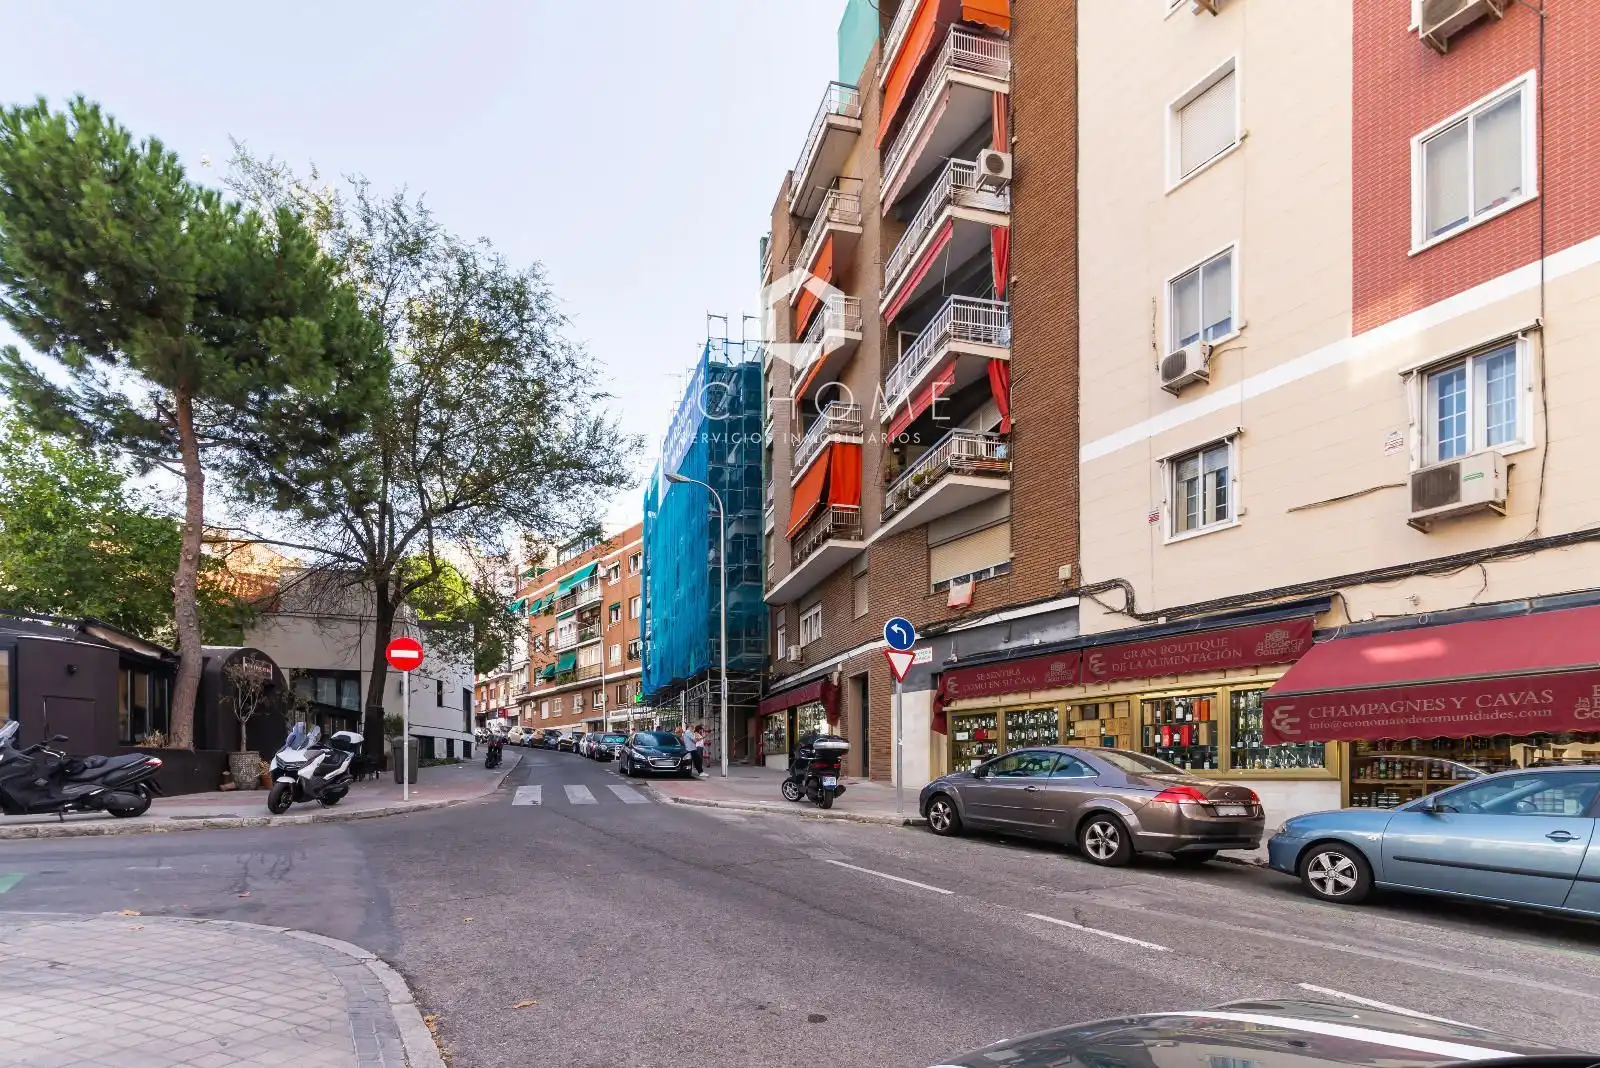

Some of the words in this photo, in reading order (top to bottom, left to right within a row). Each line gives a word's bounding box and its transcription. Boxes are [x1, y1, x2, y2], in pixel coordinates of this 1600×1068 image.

[1111, 660, 1127, 673] DE
[1129, 658, 1144, 671] LA
[1144, 648, 1243, 669] ALIMENTACIÓN
[1122, 647, 1157, 660] GRAN
[1160, 637, 1229, 655] BOUTIQUE
[1308, 697, 1446, 719] CHAMPAGNES
[1450, 696, 1467, 709] Y
[1475, 689, 1554, 708] CAVAS
[1309, 709, 1552, 731] info@economatodecomunidades.com
